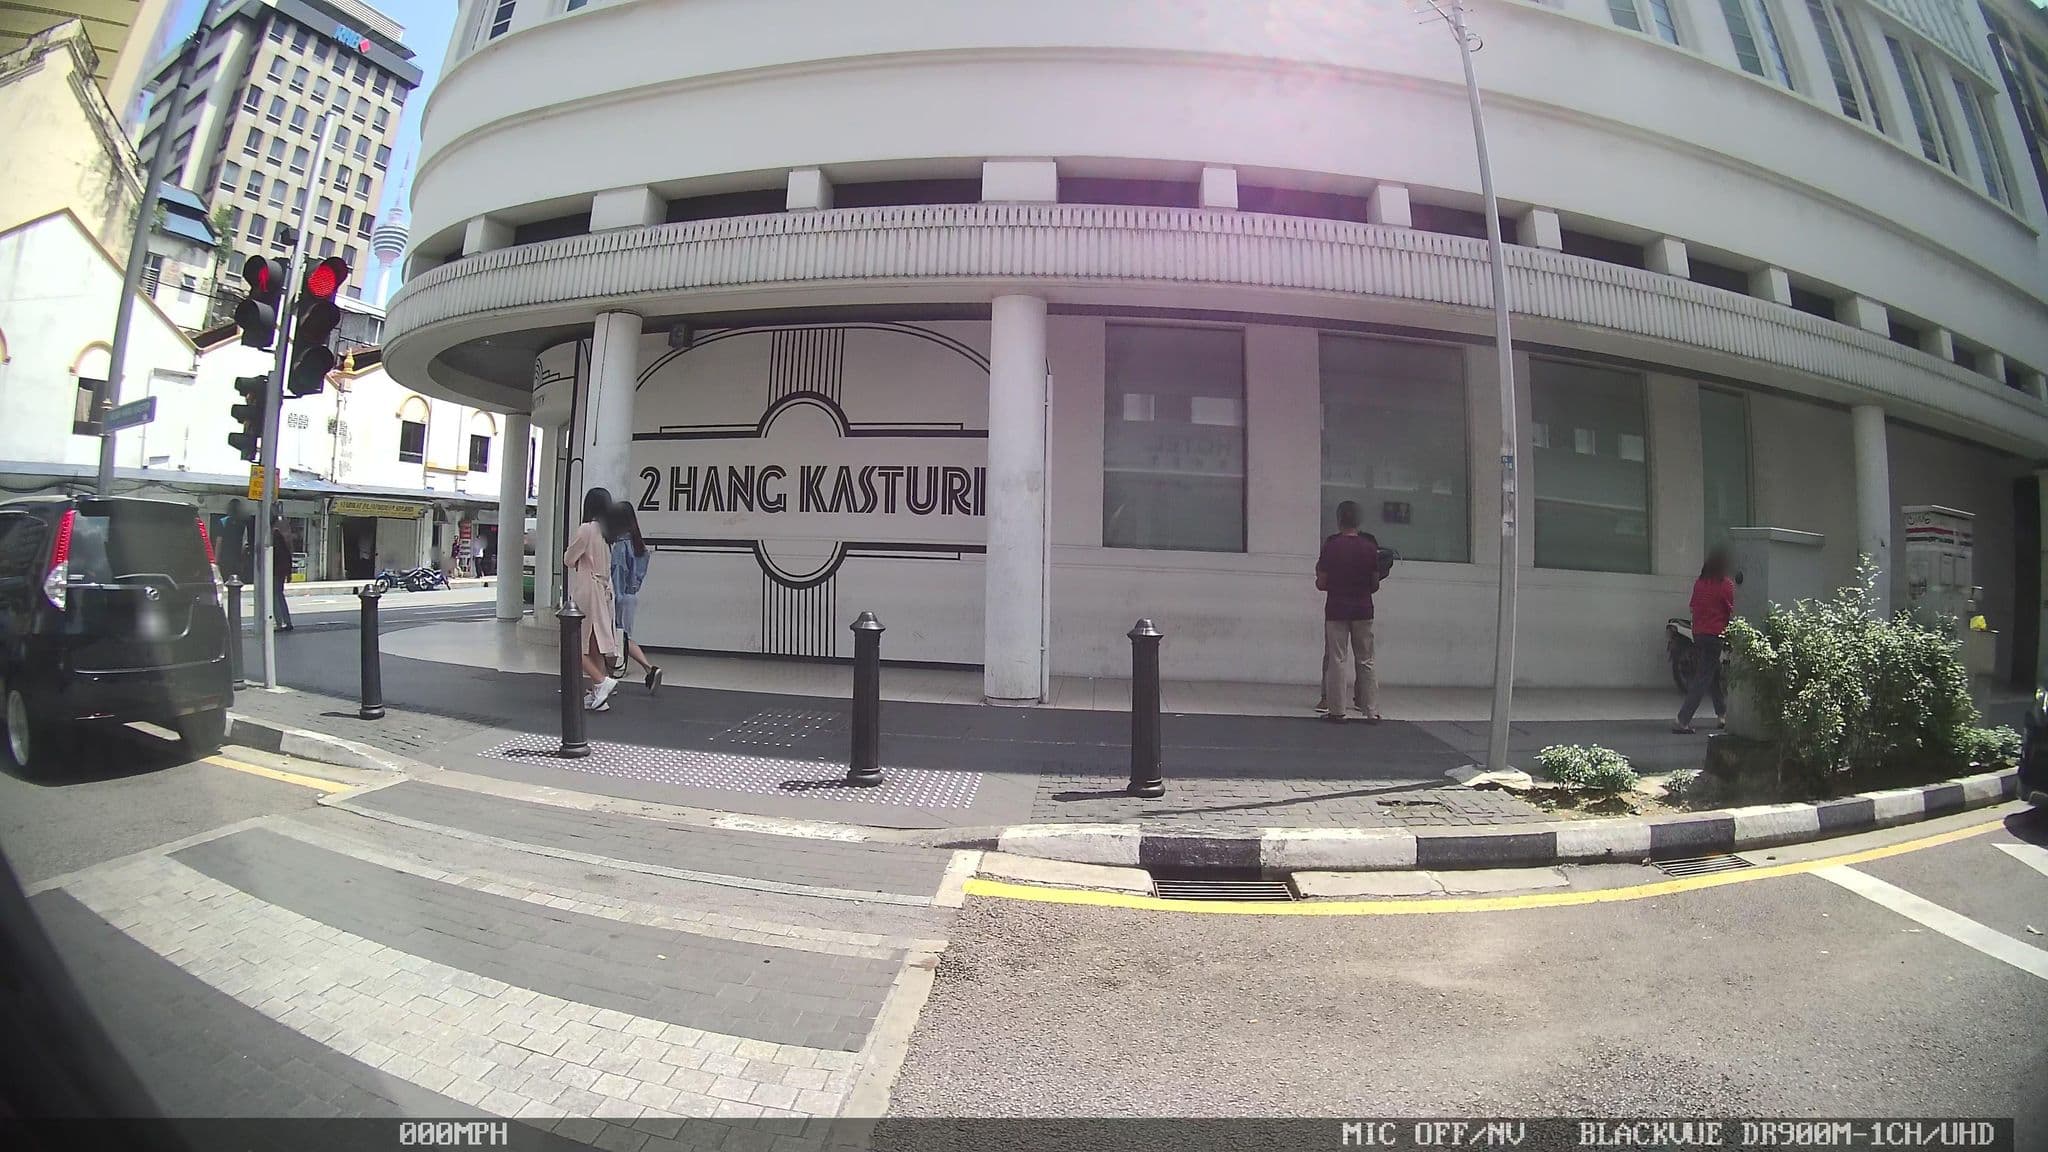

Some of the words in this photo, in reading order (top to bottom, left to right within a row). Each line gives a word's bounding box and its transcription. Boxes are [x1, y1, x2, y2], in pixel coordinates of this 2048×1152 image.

[637, 466, 661, 512] 2
[668, 464, 788, 513] HANG
[798, 465, 987, 516] KASTURI
